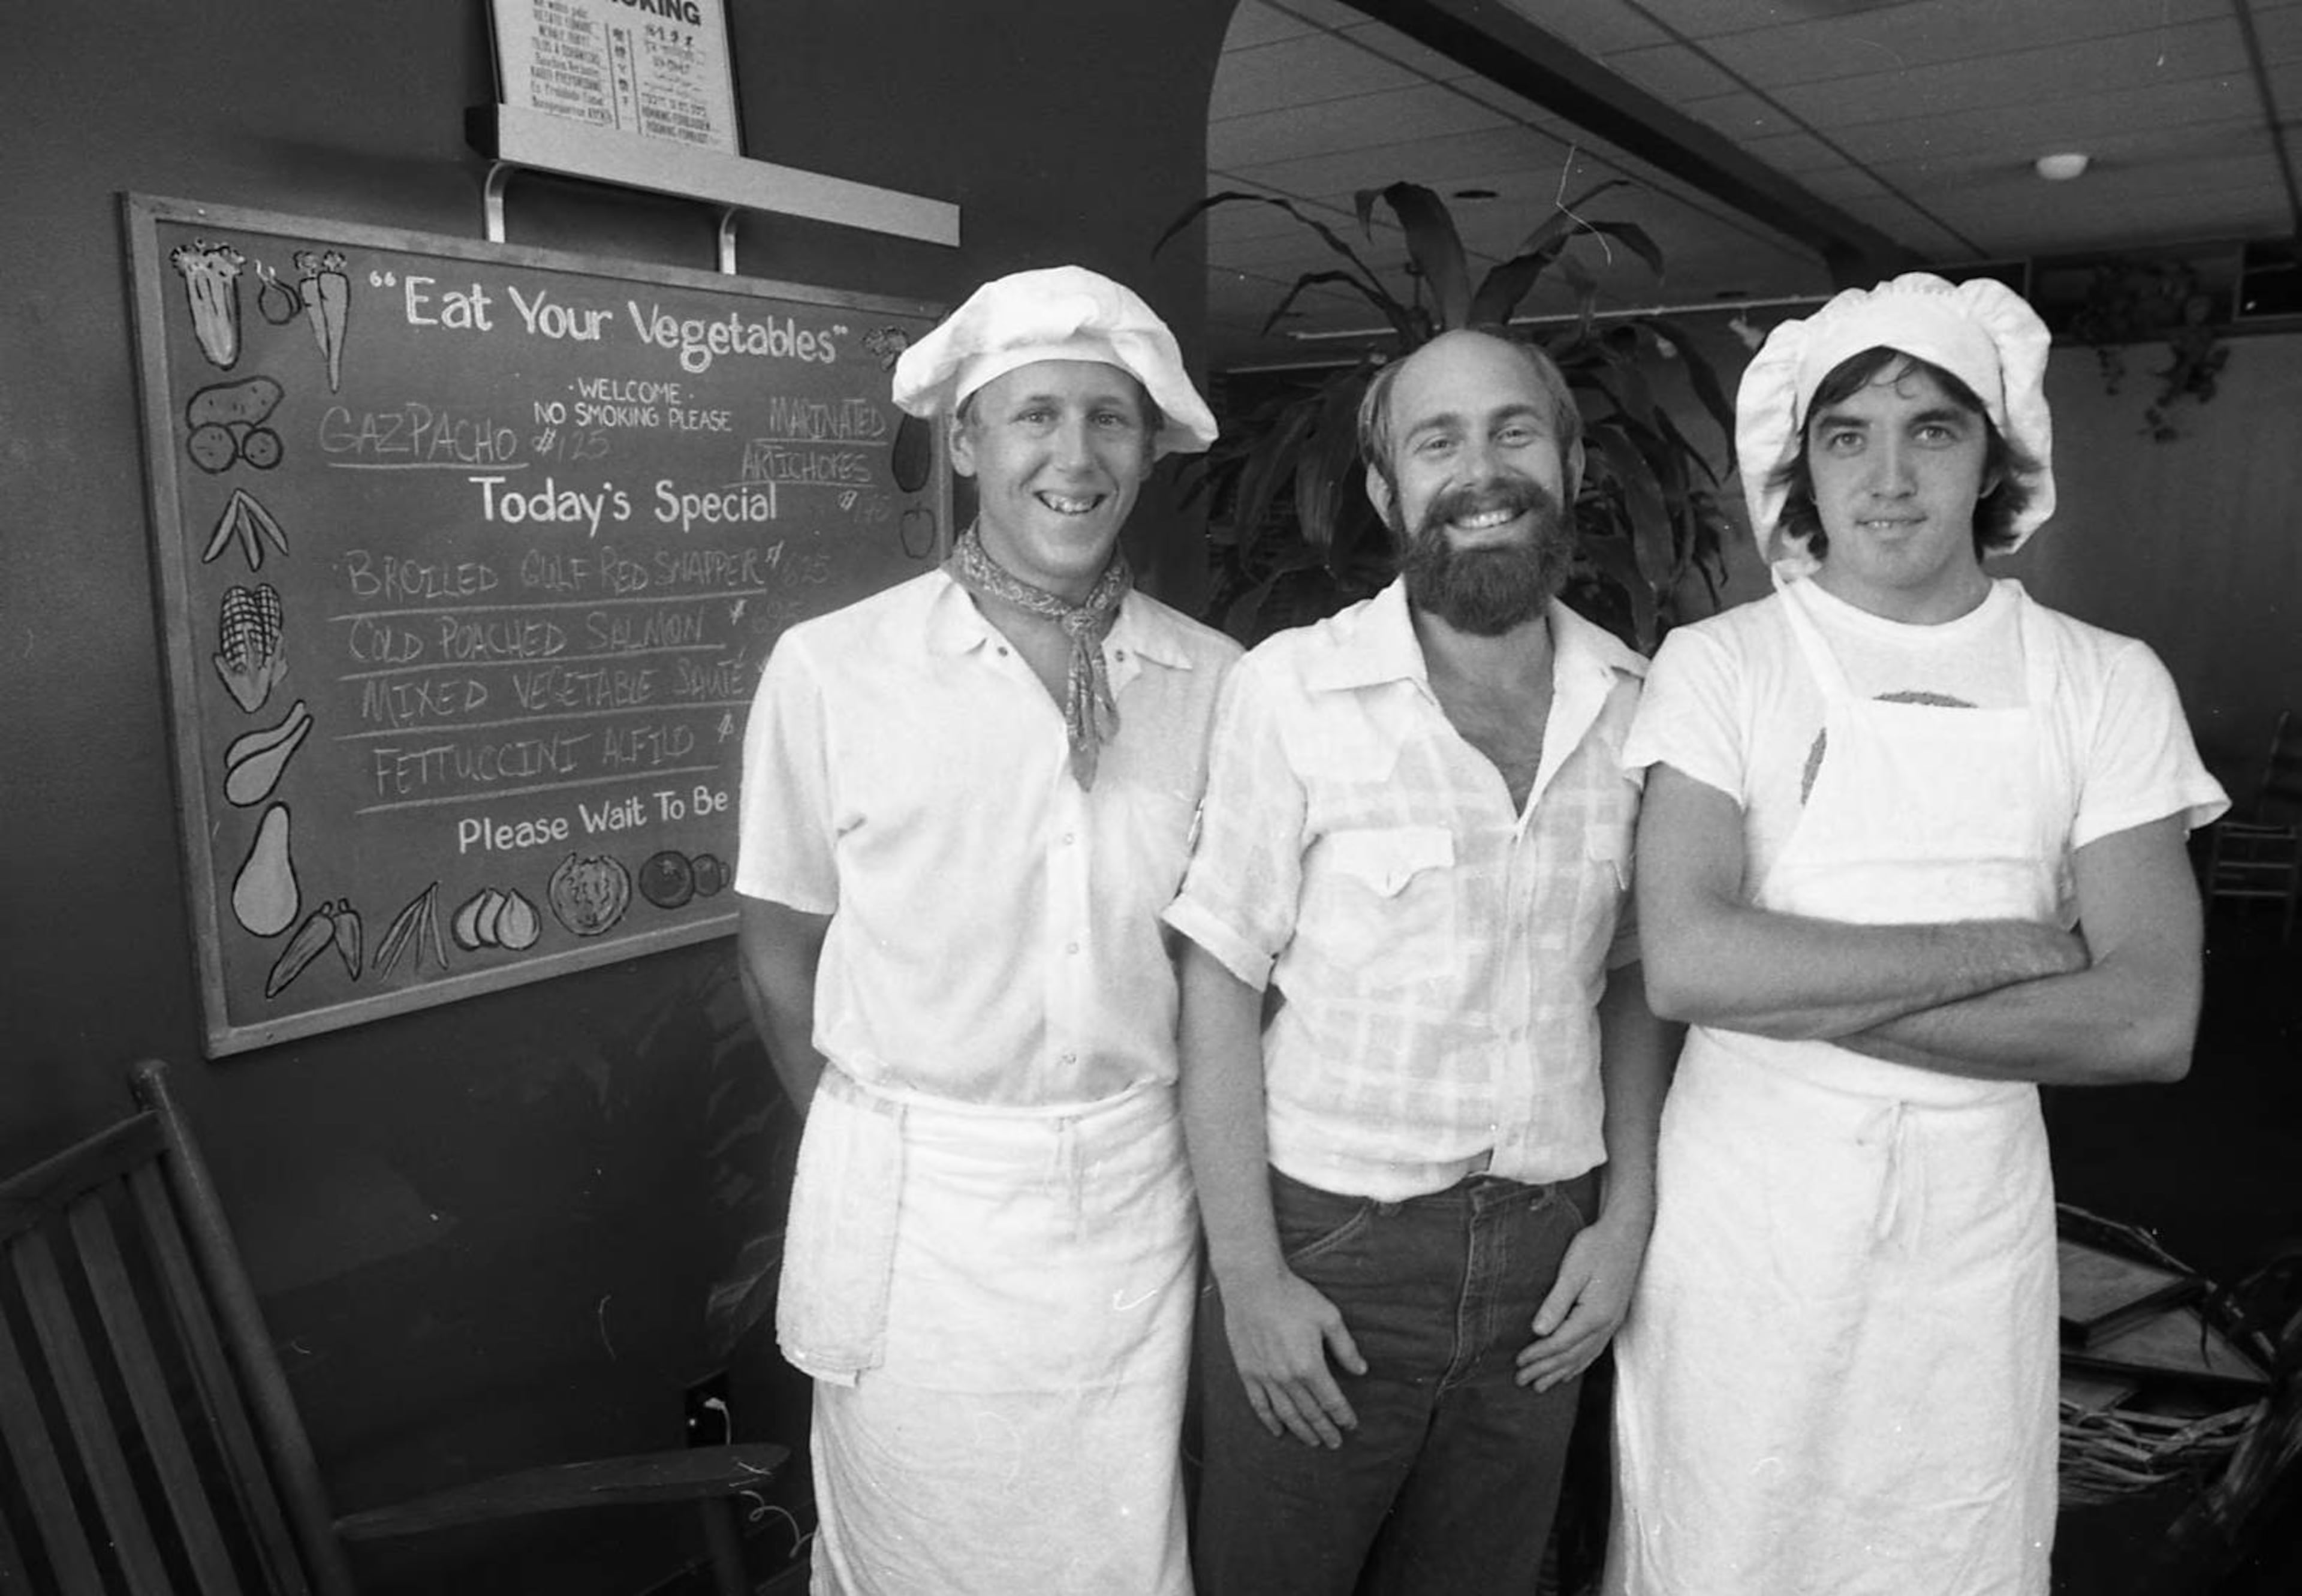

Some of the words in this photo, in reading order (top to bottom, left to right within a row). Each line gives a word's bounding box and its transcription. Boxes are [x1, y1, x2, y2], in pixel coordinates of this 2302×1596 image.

[611, 0, 701, 26] KING
[508, 285, 613, 341] Your
[534, 400, 565, 424] NO
[575, 402, 659, 427] SMOKING
[668, 409, 732, 432] PLEASE
[578, 377, 682, 404] WELCOME
[320, 402, 517, 463] GAZPACHO
[469, 477, 631, 537] Today's
[655, 480, 776, 532] Special
[342, 550, 498, 600] BROILED
[521, 549, 590, 591] GULF
[601, 546, 649, 595] RED
[655, 548, 765, 586] SNAPPER
[350, 616, 423, 661] COLD
[435, 615, 567, 660] POACHED
[587, 605, 704, 650] SALMON
[363, 679, 487, 727] MIXED
[513, 665, 658, 709] VEGETABLE
[459, 817, 568, 854] Please
[579, 797, 647, 833] Wait
[653, 790, 685, 821] To
[694, 785, 728, 815] Be
